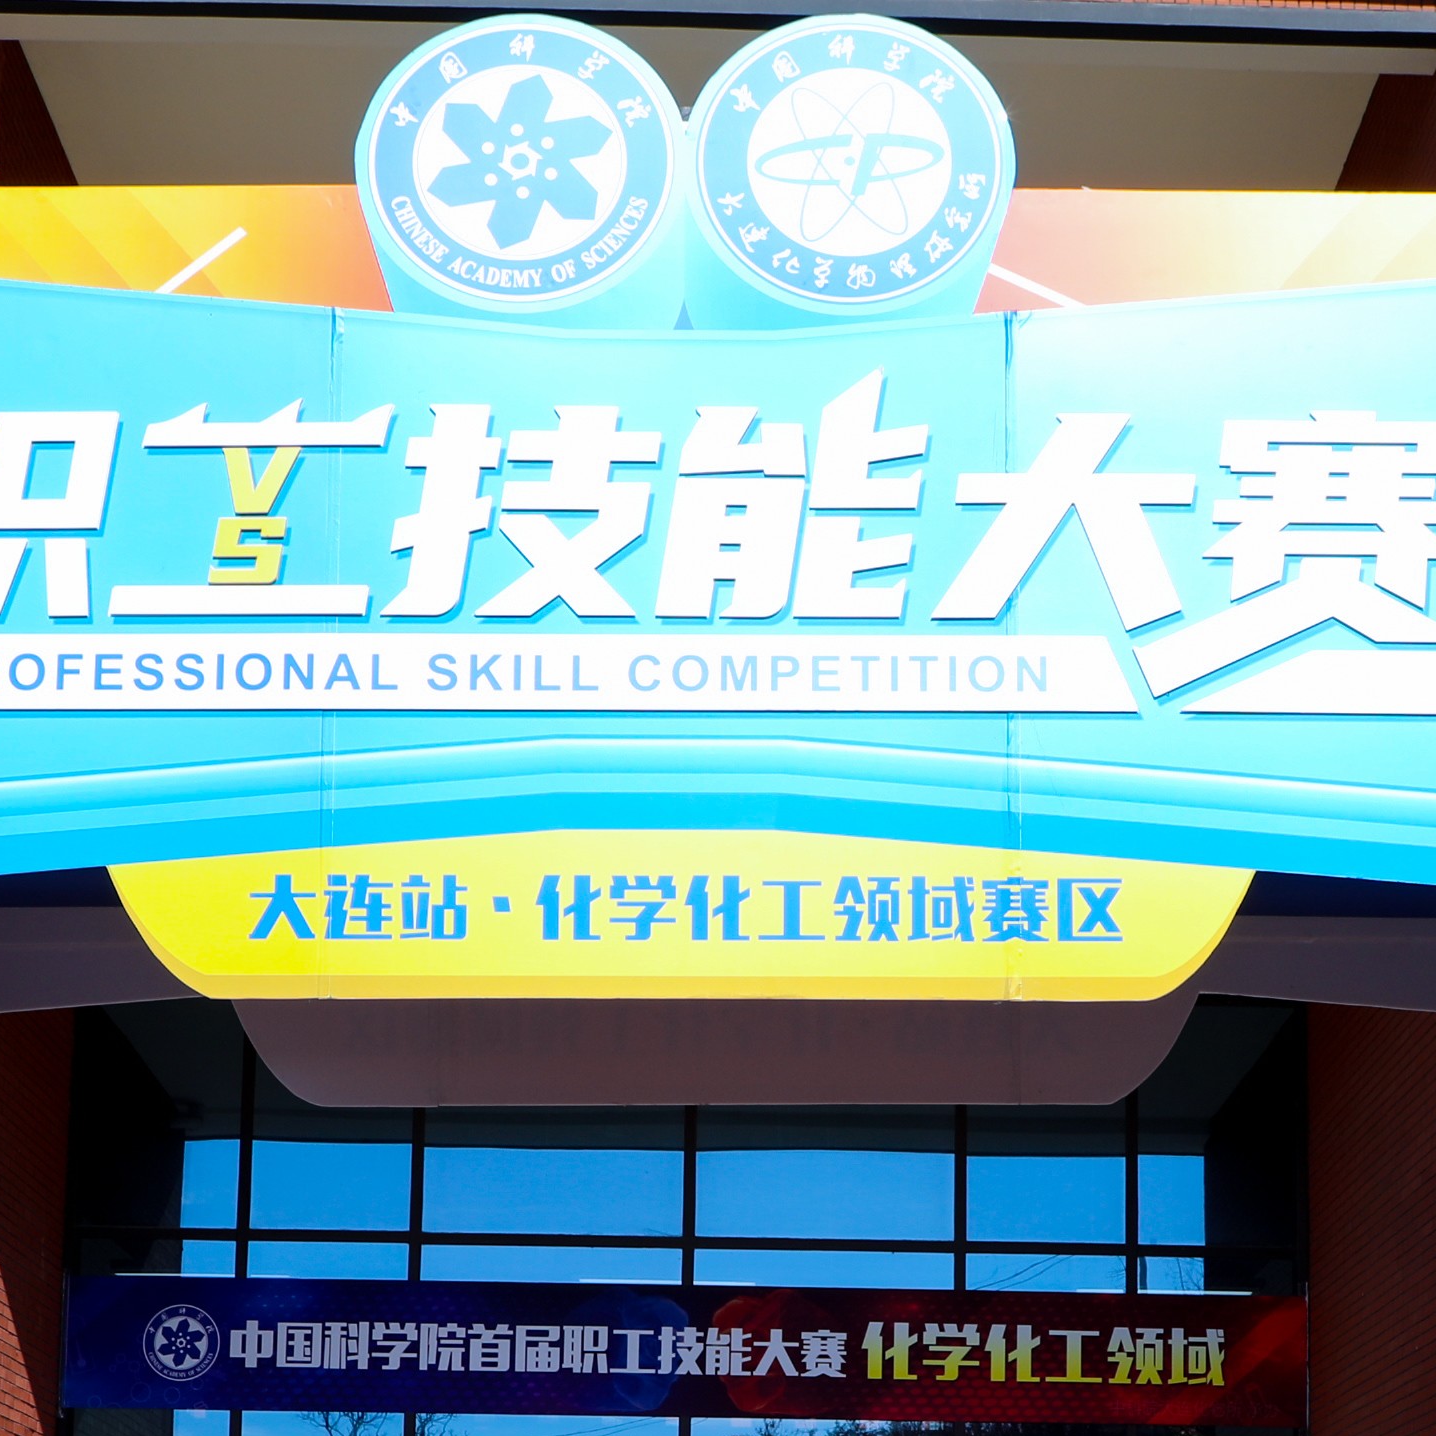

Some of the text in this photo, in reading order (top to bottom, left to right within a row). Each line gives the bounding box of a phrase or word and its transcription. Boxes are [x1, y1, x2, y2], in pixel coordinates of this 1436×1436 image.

[391, 195, 650, 288] CHINESE ACADEMY OF SCIENCES
[426, 653, 600, 693] SKILL
[627, 653, 1050, 693] COMPETITION
[229, 1319, 1226, 1386] 中国科学院首届职工技能大赛 化学化工领域
